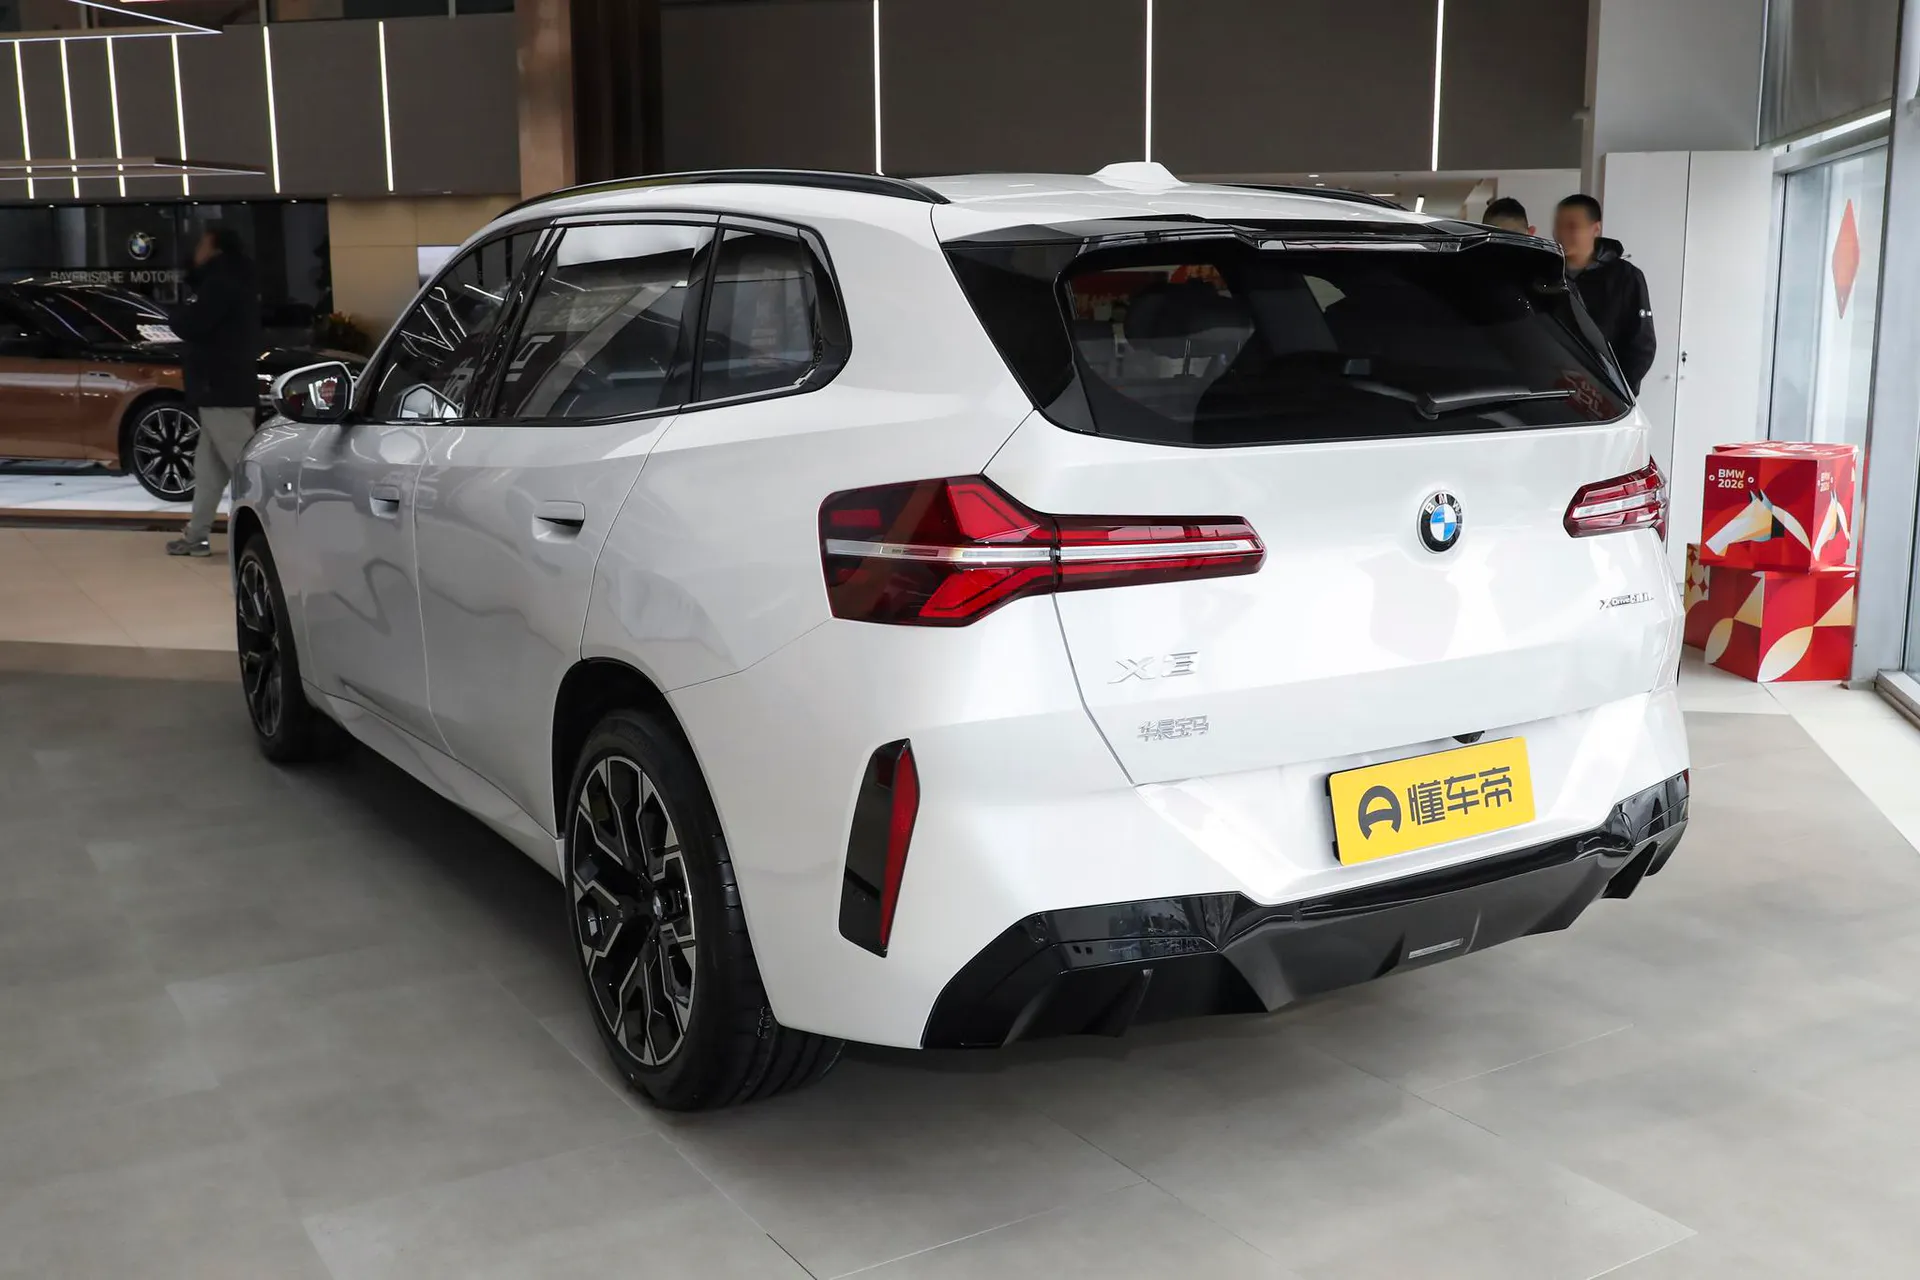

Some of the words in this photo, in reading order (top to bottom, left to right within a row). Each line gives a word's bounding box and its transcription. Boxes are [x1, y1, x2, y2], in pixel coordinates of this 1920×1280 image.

[130, 270, 184, 284] MOTORE
[1718, 468, 1745, 479] BMW
[1718, 479, 1745, 489] 2026
[1137, 715, 1210, 742] 华晨宝马
[1407, 766, 1513, 826] 懂车帝
